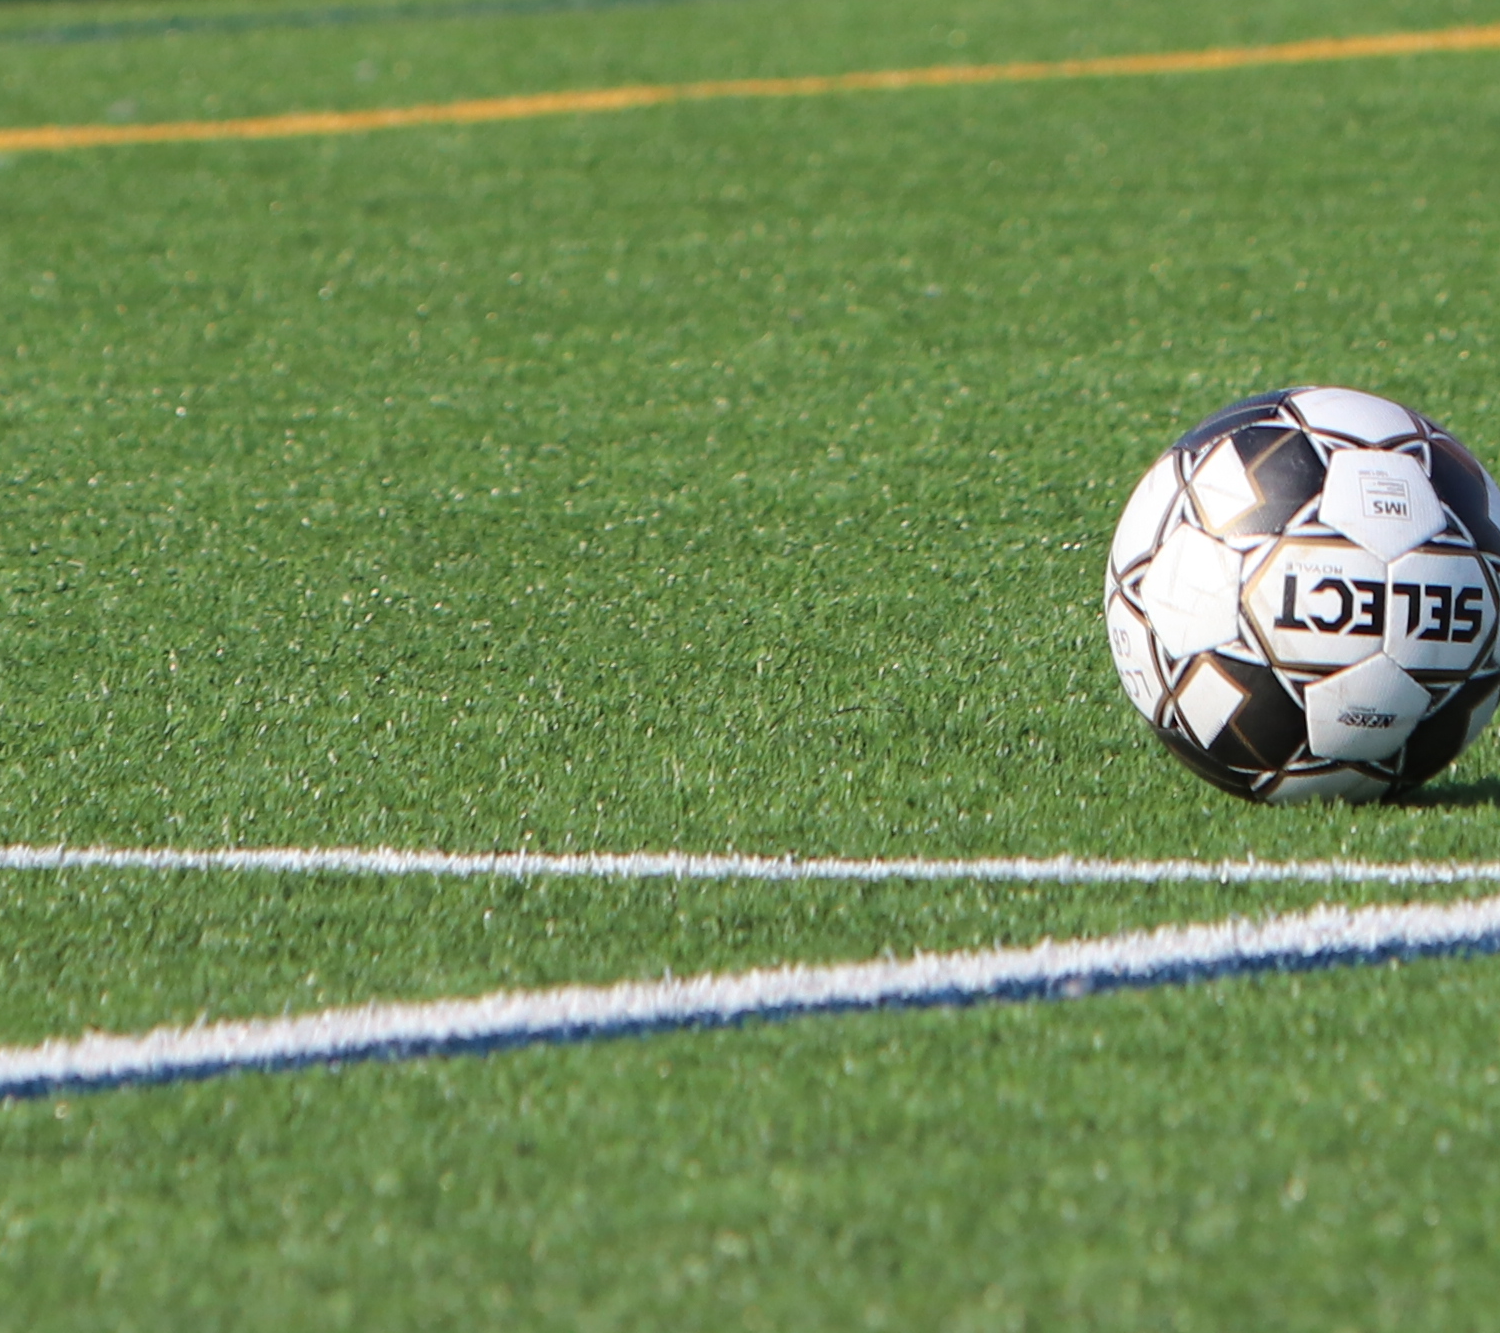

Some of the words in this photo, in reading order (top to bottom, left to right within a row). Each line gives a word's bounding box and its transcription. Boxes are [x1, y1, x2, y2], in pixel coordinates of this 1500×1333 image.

[1373, 501, 1407, 516] IMS
[1285, 563, 1342, 575] ROYALE
[1274, 575, 1483, 642] SELECT
